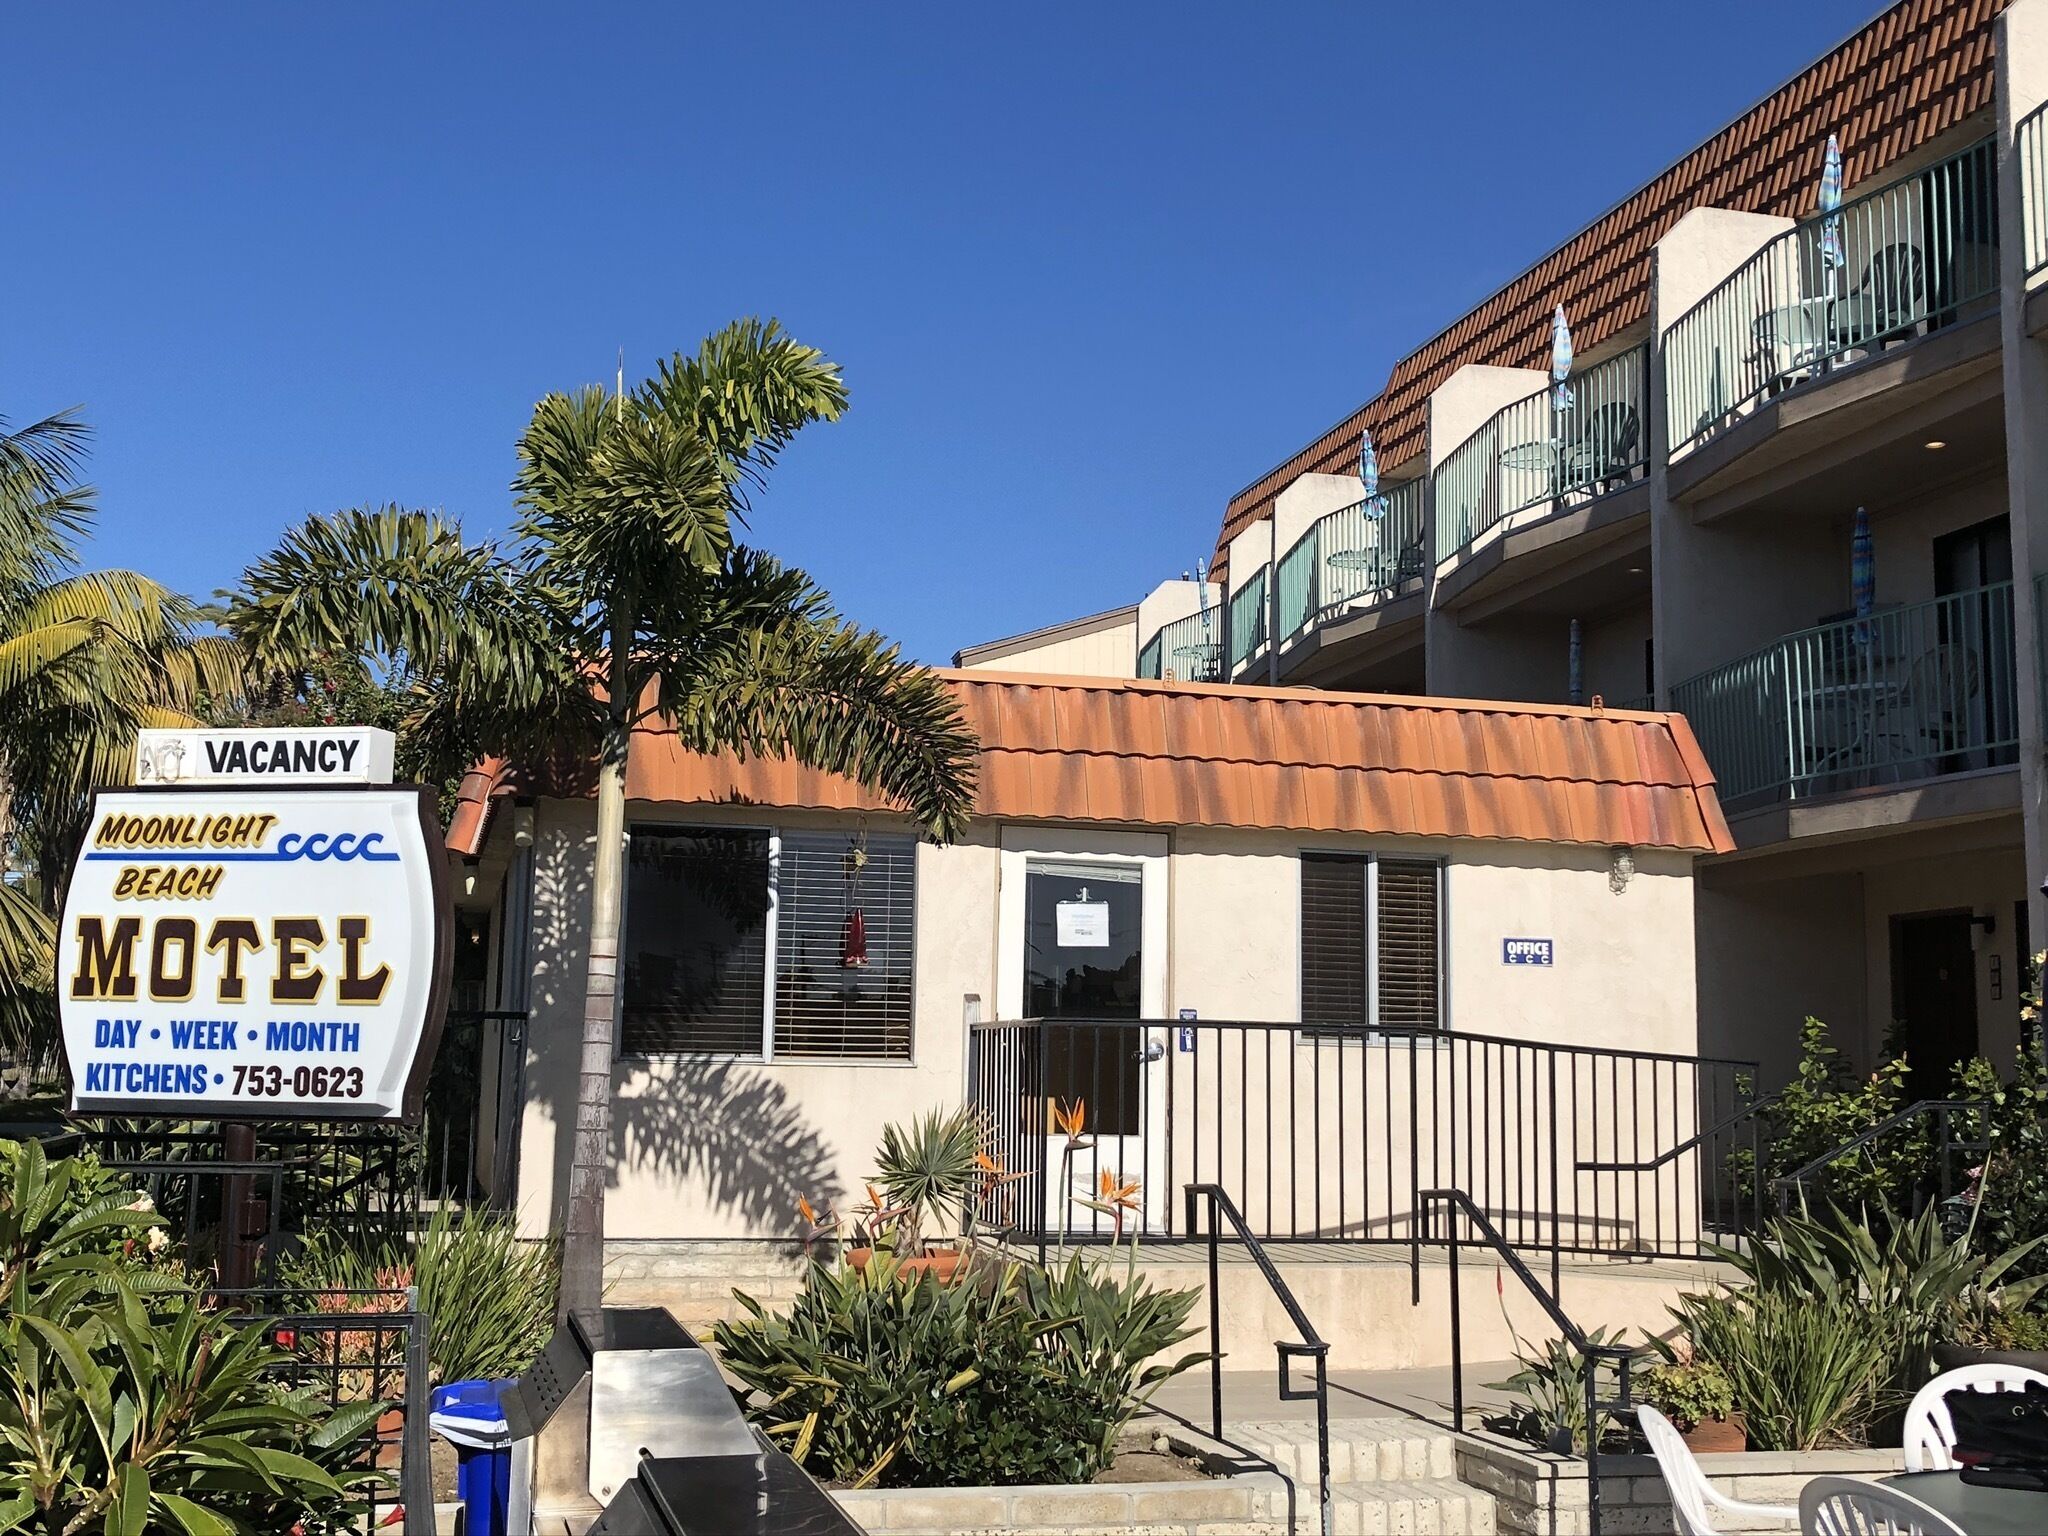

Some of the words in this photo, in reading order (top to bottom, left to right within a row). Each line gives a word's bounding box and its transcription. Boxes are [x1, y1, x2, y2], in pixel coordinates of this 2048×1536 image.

[205, 739, 360, 773] VACANCY
[94, 812, 279, 850] MOONLIGHT
[113, 864, 227, 900] BEACH
[69, 915, 394, 1006] MOTEL
[1506, 941, 1550, 956] OFFICE
[94, 1019, 142, 1049] DAY
[171, 1020, 238, 1051] WEEK
[265, 1021, 360, 1052] MONTH
[85, 1063, 208, 1094] KITCHENS
[232, 1065, 364, 1098] 753-0623
